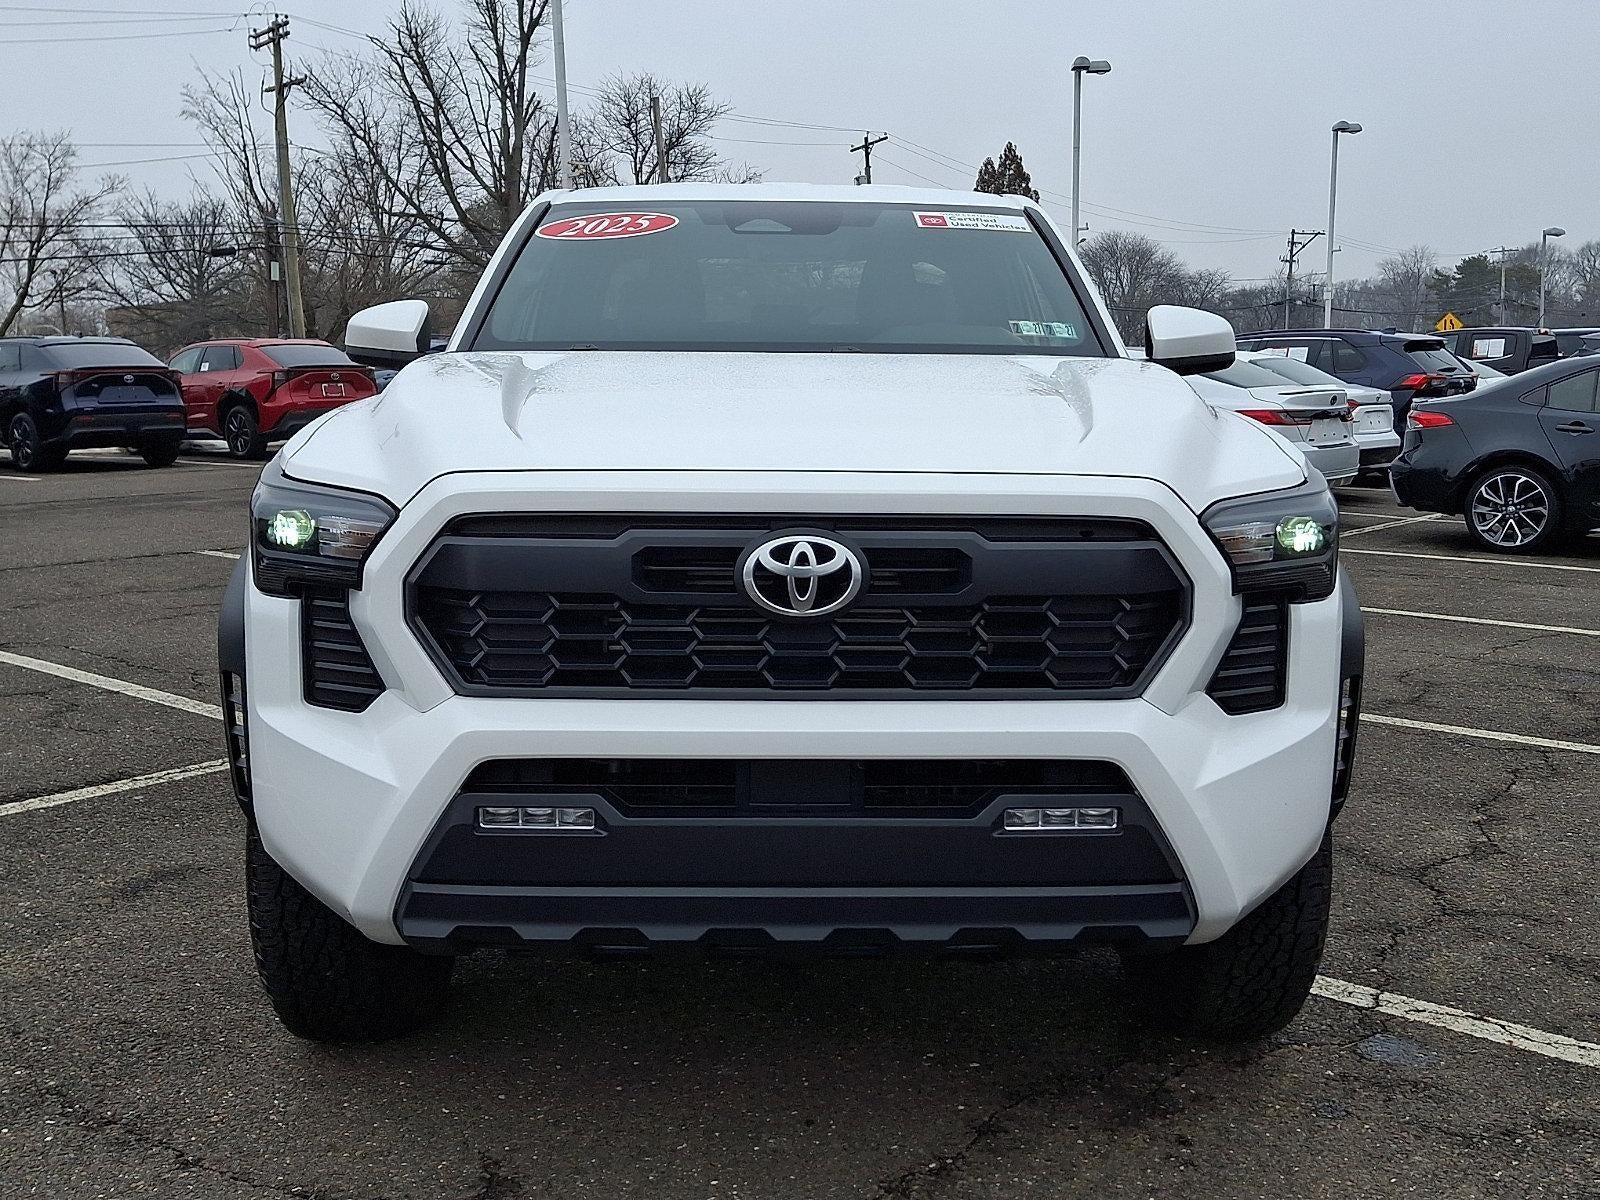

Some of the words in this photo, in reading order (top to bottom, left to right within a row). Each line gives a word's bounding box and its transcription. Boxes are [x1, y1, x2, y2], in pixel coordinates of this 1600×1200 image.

[948, 215, 998, 223] Certified
[557, 215, 658, 237] 2025
[981, 223, 1027, 231] Vehicles
